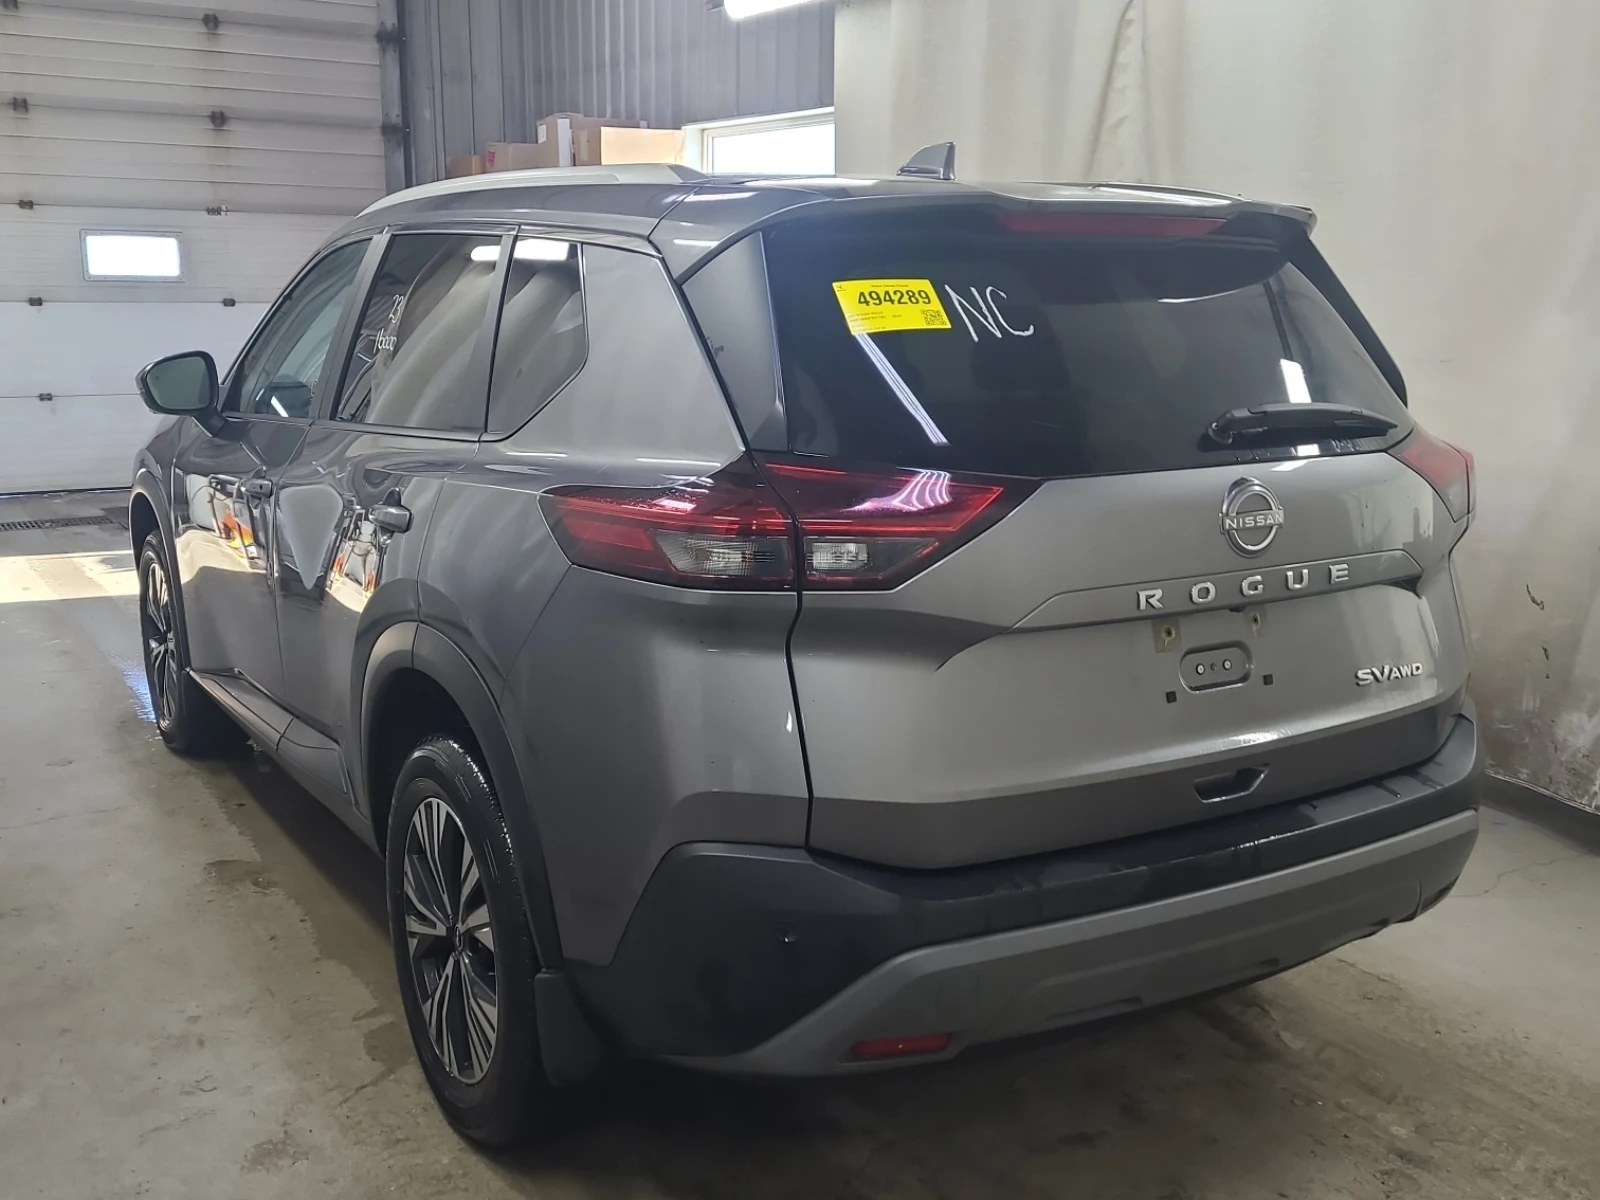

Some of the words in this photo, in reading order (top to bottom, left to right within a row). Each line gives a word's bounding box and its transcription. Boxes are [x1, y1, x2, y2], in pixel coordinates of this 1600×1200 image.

[388, 294, 404, 323] 23
[857, 289, 932, 307] 494289
[944, 284, 1035, 343] NC
[1224, 513, 1284, 530] NISSAN
[1137, 563, 1351, 611] ROGUE
